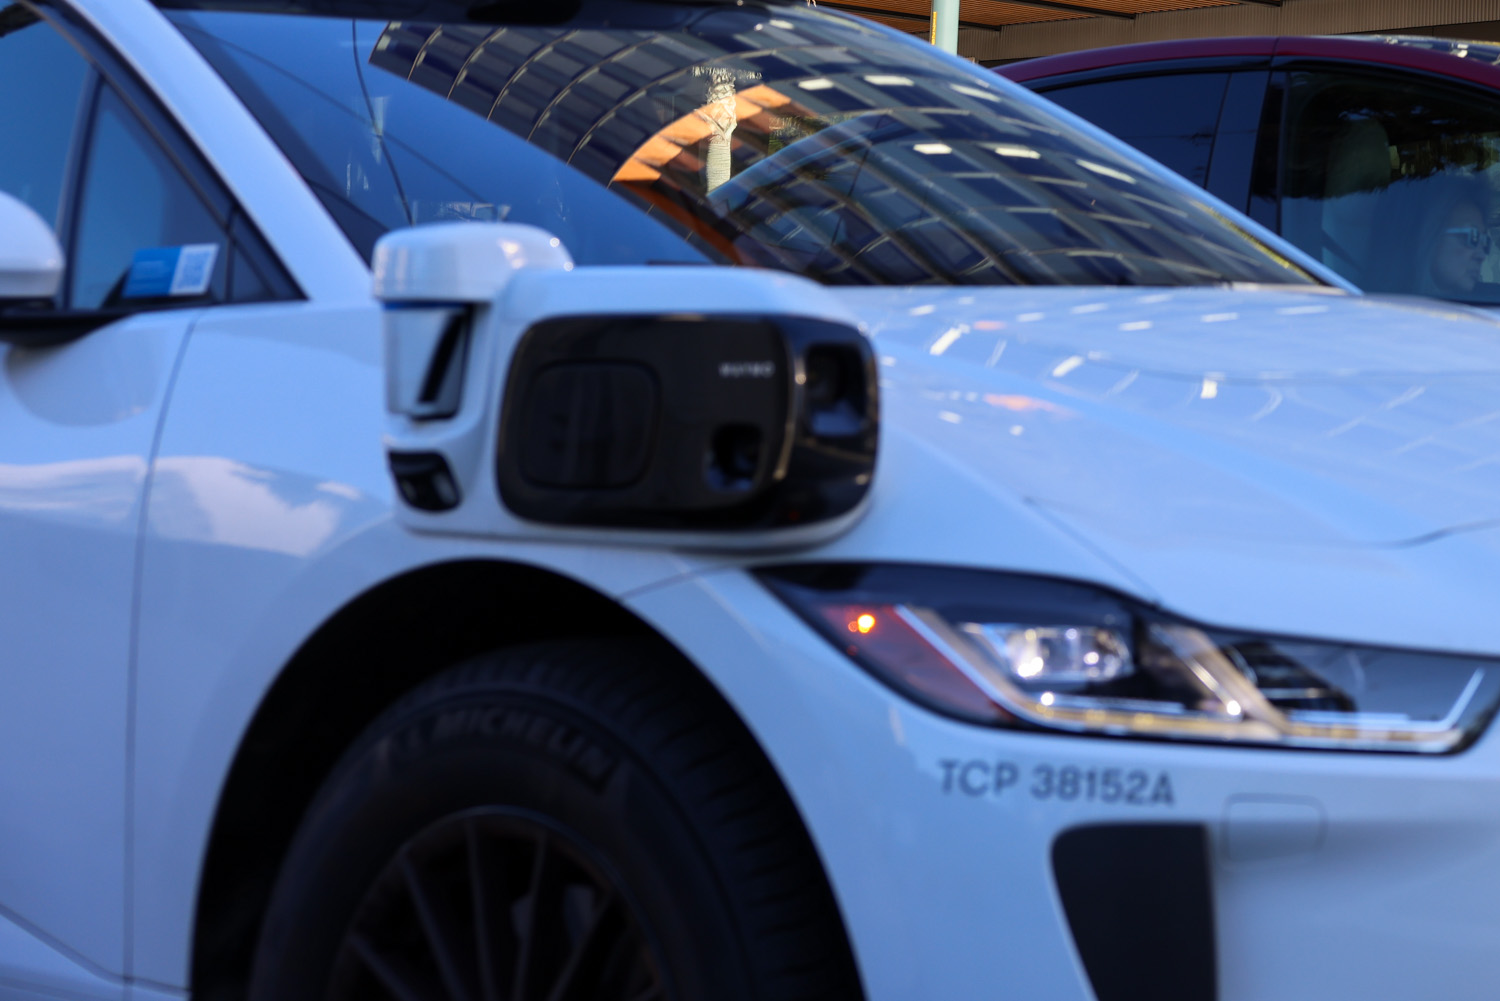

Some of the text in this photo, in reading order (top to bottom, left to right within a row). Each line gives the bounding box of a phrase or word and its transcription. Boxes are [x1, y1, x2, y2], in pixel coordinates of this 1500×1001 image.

[430, 707, 617, 787] MICHELIN
[939, 759, 1175, 806] TCP 38152A
